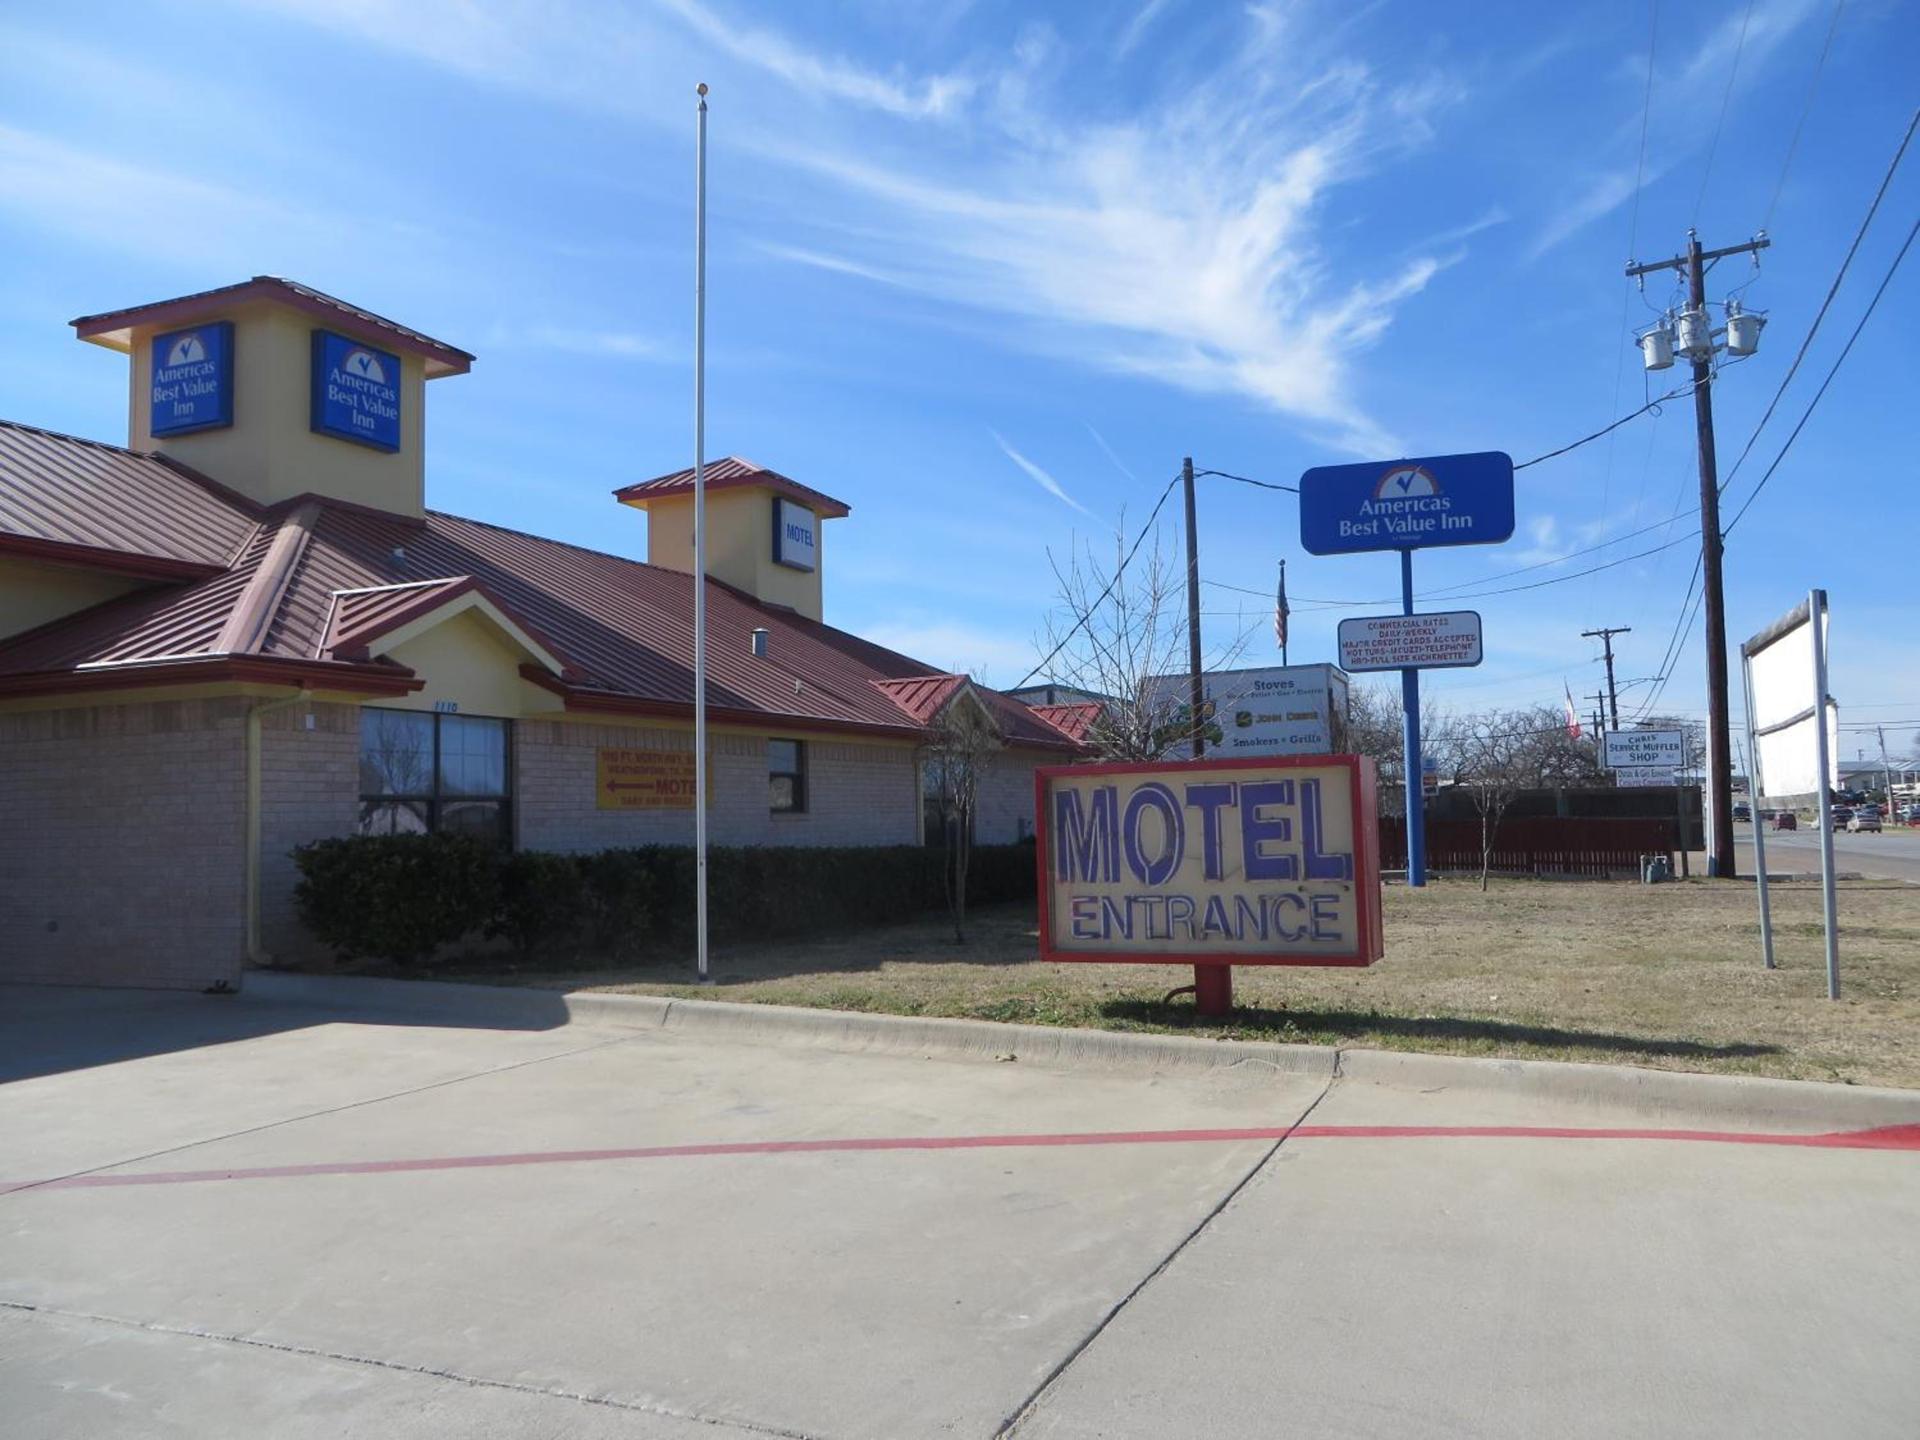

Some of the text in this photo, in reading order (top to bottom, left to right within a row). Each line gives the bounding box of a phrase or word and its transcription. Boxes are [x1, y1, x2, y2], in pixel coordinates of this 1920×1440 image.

[156, 361, 216, 384] Americas
[153, 379, 217, 403] Best Value
[329, 368, 396, 401] Americas
[173, 400, 195, 416] Inn
[328, 384, 398, 420] Best Value
[352, 410, 375, 430] Inn
[1359, 496, 1451, 516] Americas
[786, 522, 814, 547] MOTEL
[1340, 512, 1472, 537] Best Value Inn
[1371, 638, 1401, 648] CREDIT
[1403, 636, 1431, 646] CARDS
[1434, 634, 1476, 643] ACCEPTED
[1254, 680, 1294, 691] Stoves
[1233, 734, 1321, 747] Smokers Grills
[1643, 742, 1679, 751] MUFFLER
[1629, 752, 1659, 761] SHOP
[655, 779, 698, 796] MOTE
[1055, 778, 1353, 886] MOTEL
[1071, 892, 1342, 943] ENTRANCE
